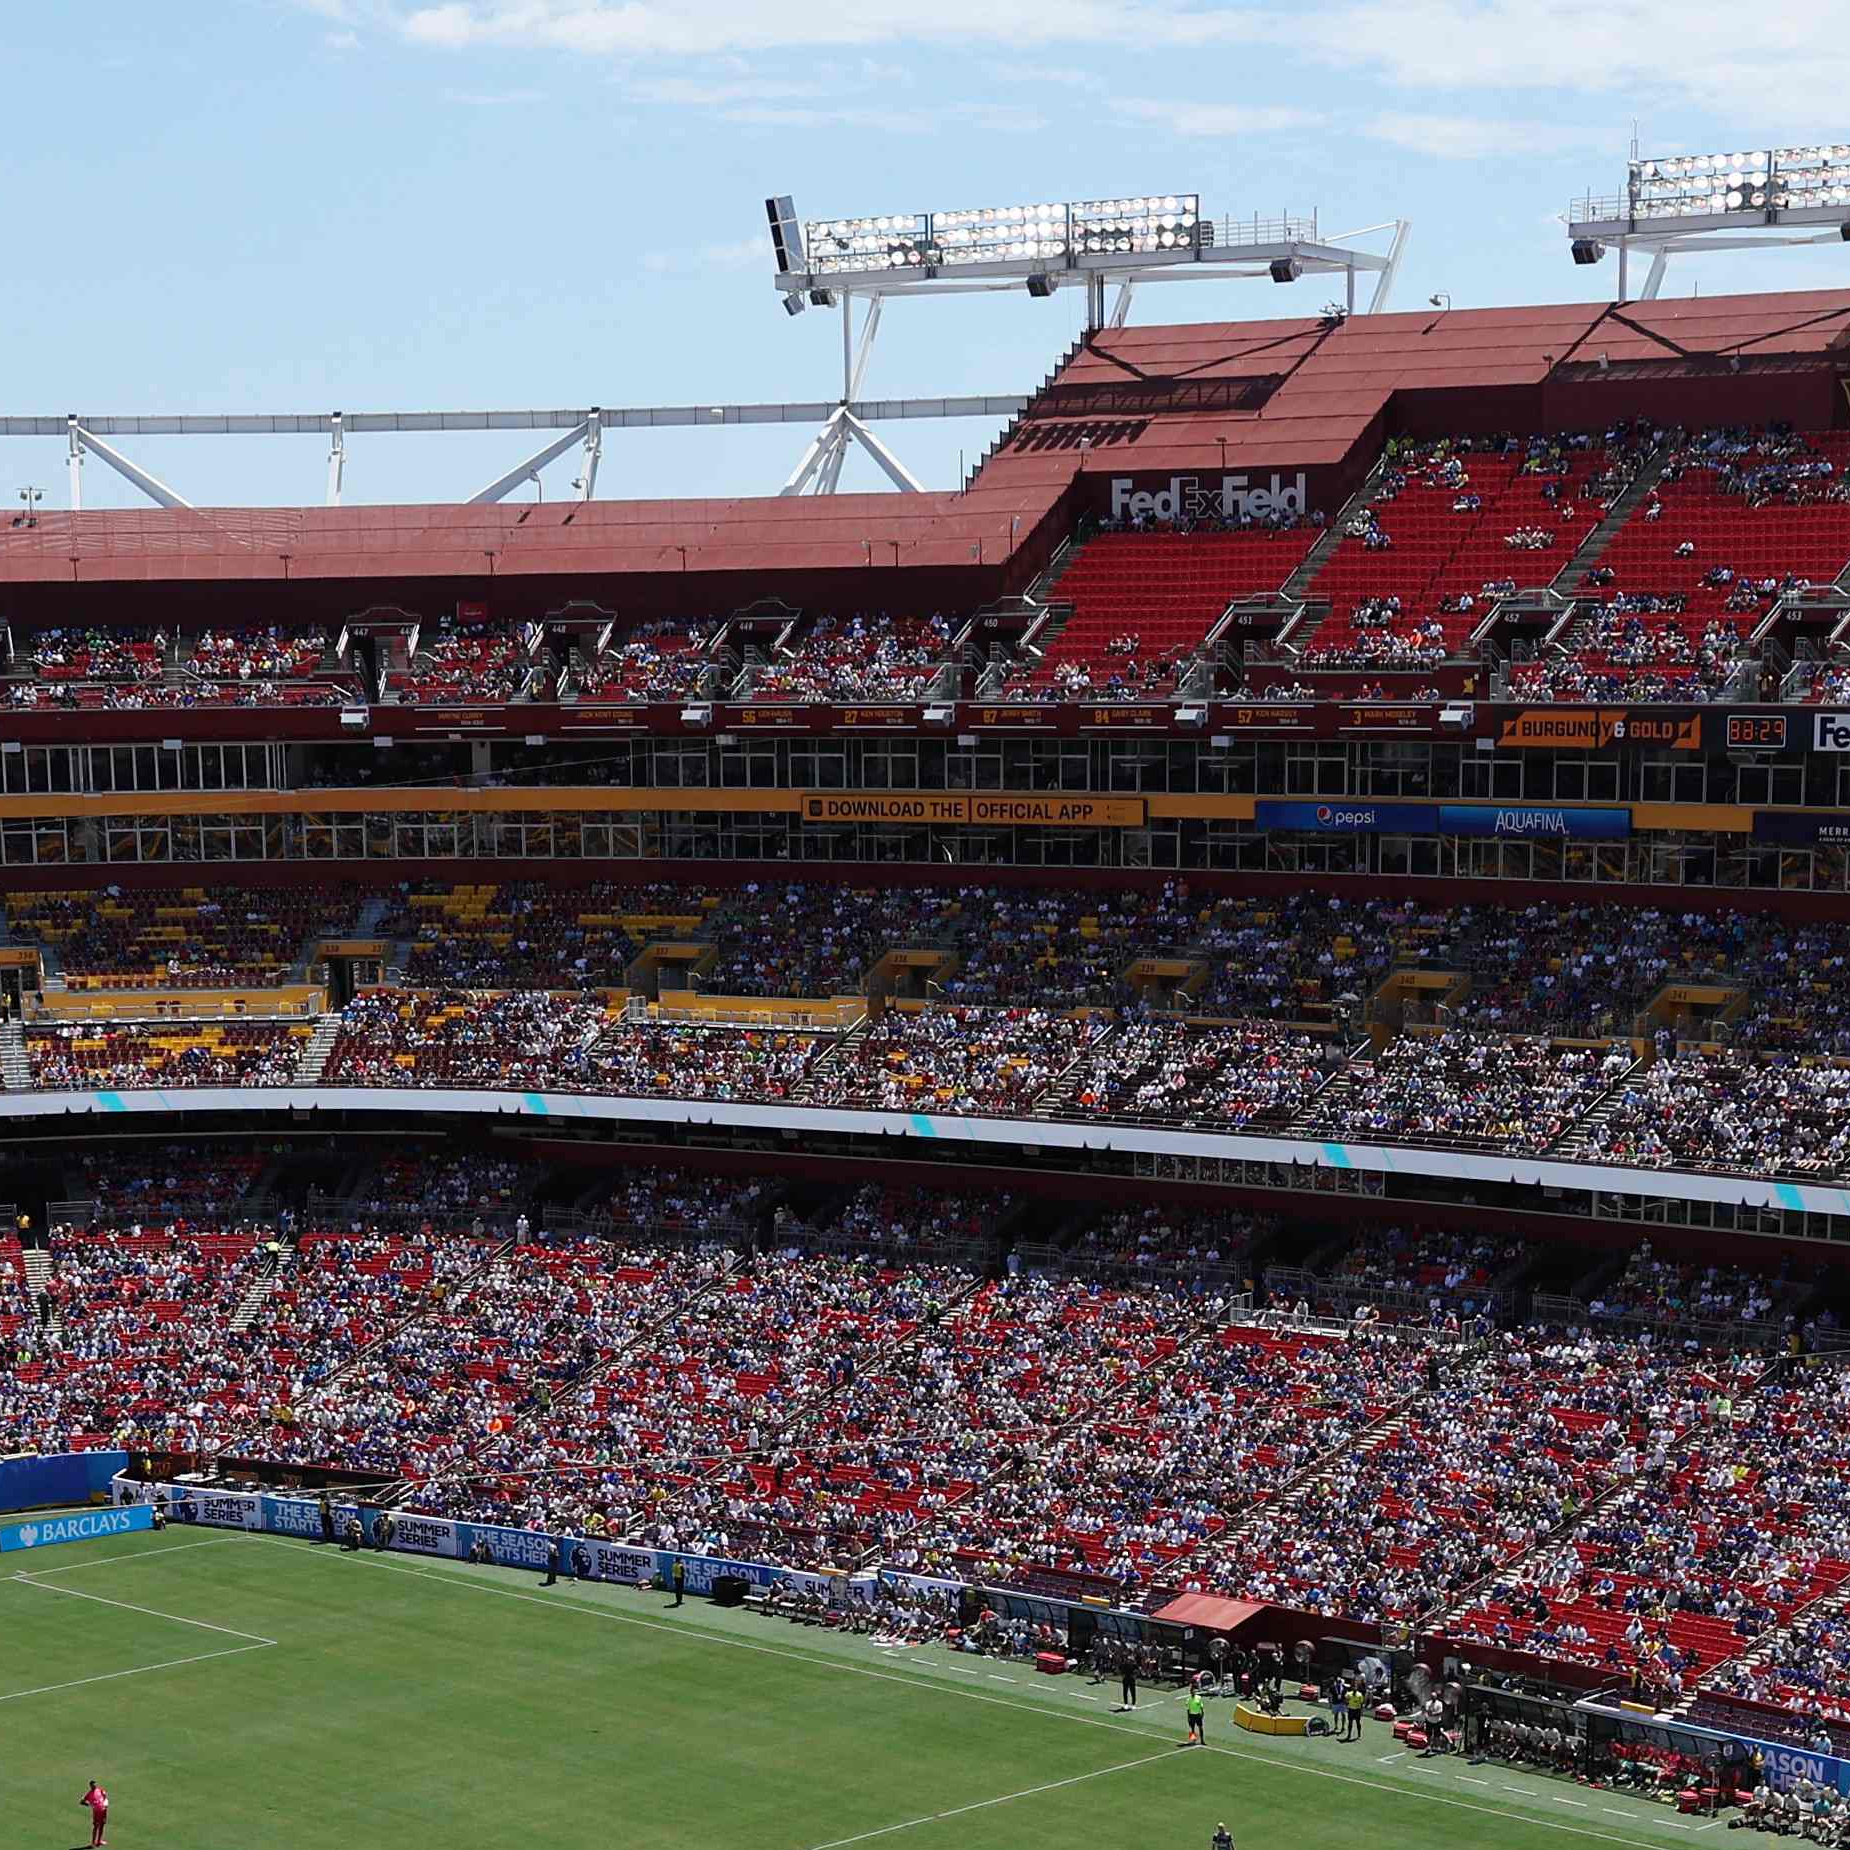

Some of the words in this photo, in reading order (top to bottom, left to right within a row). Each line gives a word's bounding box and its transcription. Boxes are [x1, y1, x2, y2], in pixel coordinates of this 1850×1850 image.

[1111, 472, 1306, 519] FedExField
[983, 617, 998, 628] 450
[1237, 614, 1253, 625] 451
[1504, 612, 1520, 623] 452
[1786, 611, 1803, 621] 453
[844, 709, 858, 724] 27
[1237, 710, 1253, 724] 57
[1353, 710, 1363, 725] 3
[1522, 720, 1613, 739] BURGUNDY
[1613, 720, 1626, 739] &
[1629, 721, 1672, 739] GOLD
[827, 800, 925, 818] DOWNLOAD
[929, 801, 964, 819] THE
[976, 803, 1053, 820] OFFICIAL
[1058, 803, 1094, 821] APP
[1334, 808, 1377, 827] pepsi
[1494, 810, 1567, 834] AQUAFINA
[203, 1508, 245, 1523] SERIES
[276, 1503, 302, 1518] THE
[303, 1505, 357, 1523] SESON
[41, 1507, 131, 1545] BARCLAYS
[275, 1516, 323, 1534] STARTS
[398, 1518, 451, 1538] SUMMER
[398, 1531, 439, 1548] SERIES
[472, 1528, 499, 1544] THE
[597, 1549, 652, 1569] SUMMER
[597, 1561, 640, 1578] SERIES
